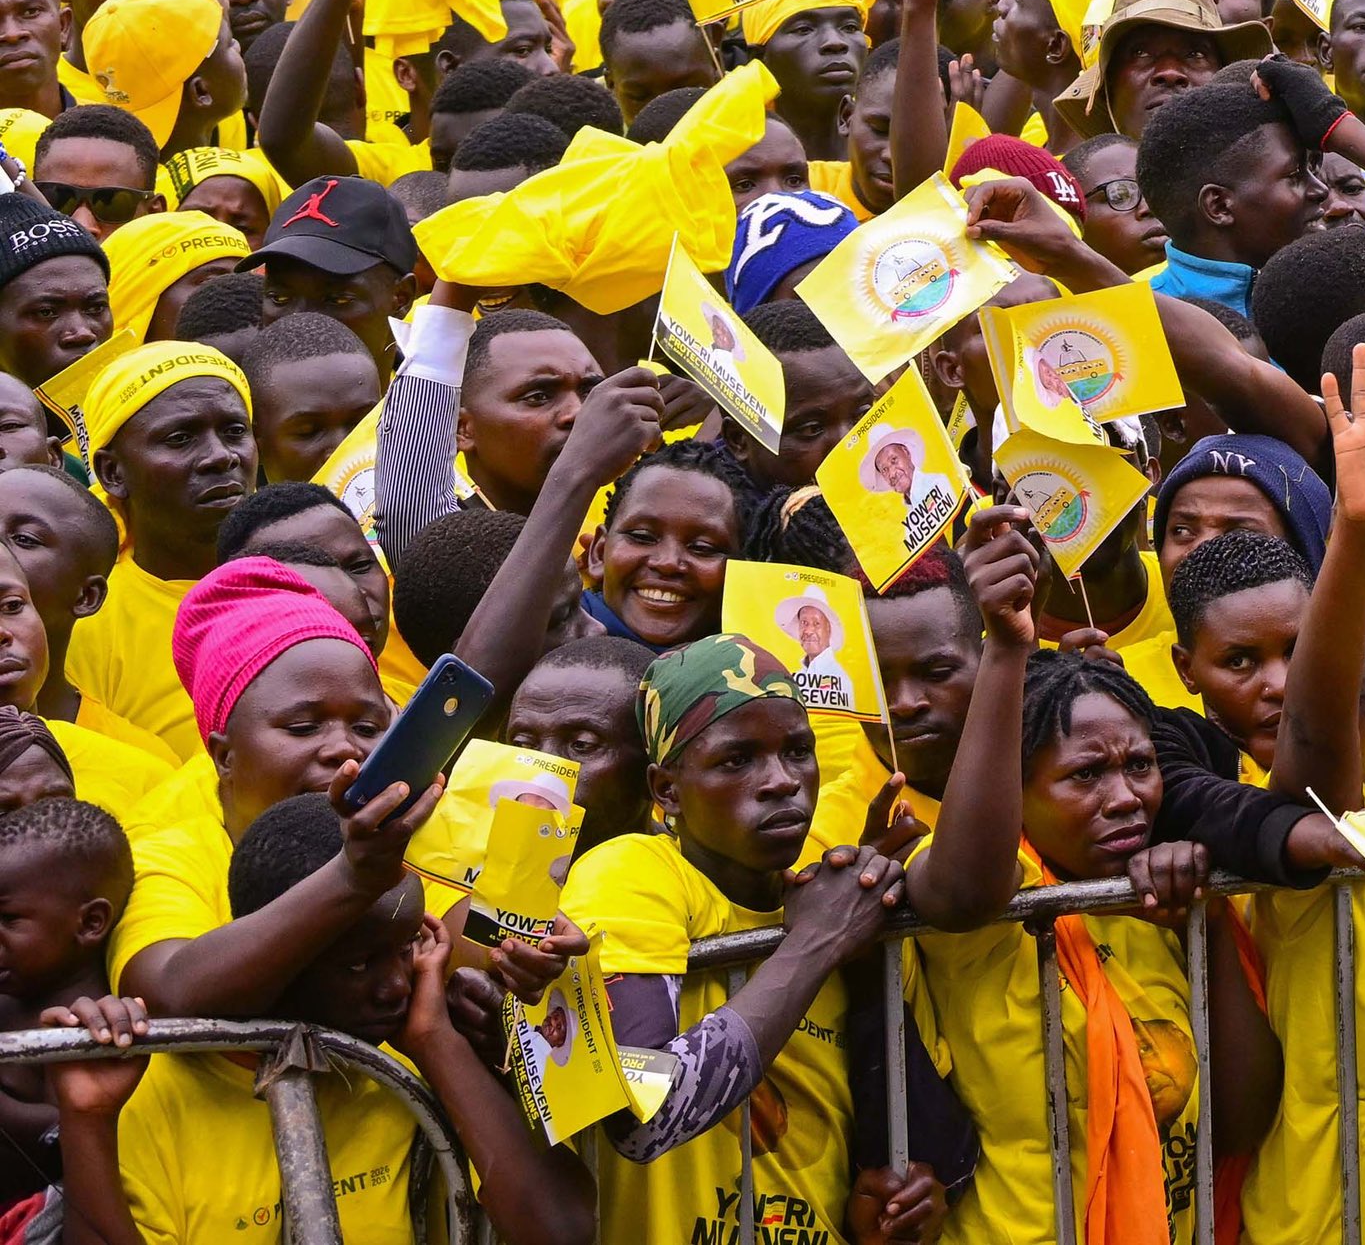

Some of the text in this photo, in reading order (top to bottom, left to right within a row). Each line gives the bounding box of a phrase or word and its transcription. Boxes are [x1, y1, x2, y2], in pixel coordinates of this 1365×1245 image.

[1046, 170, 1080, 202] LA
[9, 218, 79, 251] BOSS
[180, 235, 250, 253] PRESIDEN
[668, 317, 768, 418] YOWERI MUSEVENI
[668, 334, 760, 424] PROTECTING THE GAINS
[857, 402, 888, 439] PRESIDENT
[1209, 450, 1256, 476] NY
[901, 484, 944, 532] YOWERI
[903, 492, 955, 553] MUSEVENI
[800, 573, 830, 587] PRESIDENT
[802, 690, 849, 707] SEVENI
[534, 757, 580, 779] PRESIDEN
[496, 908, 554, 935] YOWER
[576, 986, 598, 1055] PRESIDENT
[515, 1056, 539, 1121] THE GAINS
[522, 1040, 553, 1123] MUSEVENI
[369, 1164, 391, 1178] 2026
[370, 1175, 392, 1187] 2031
